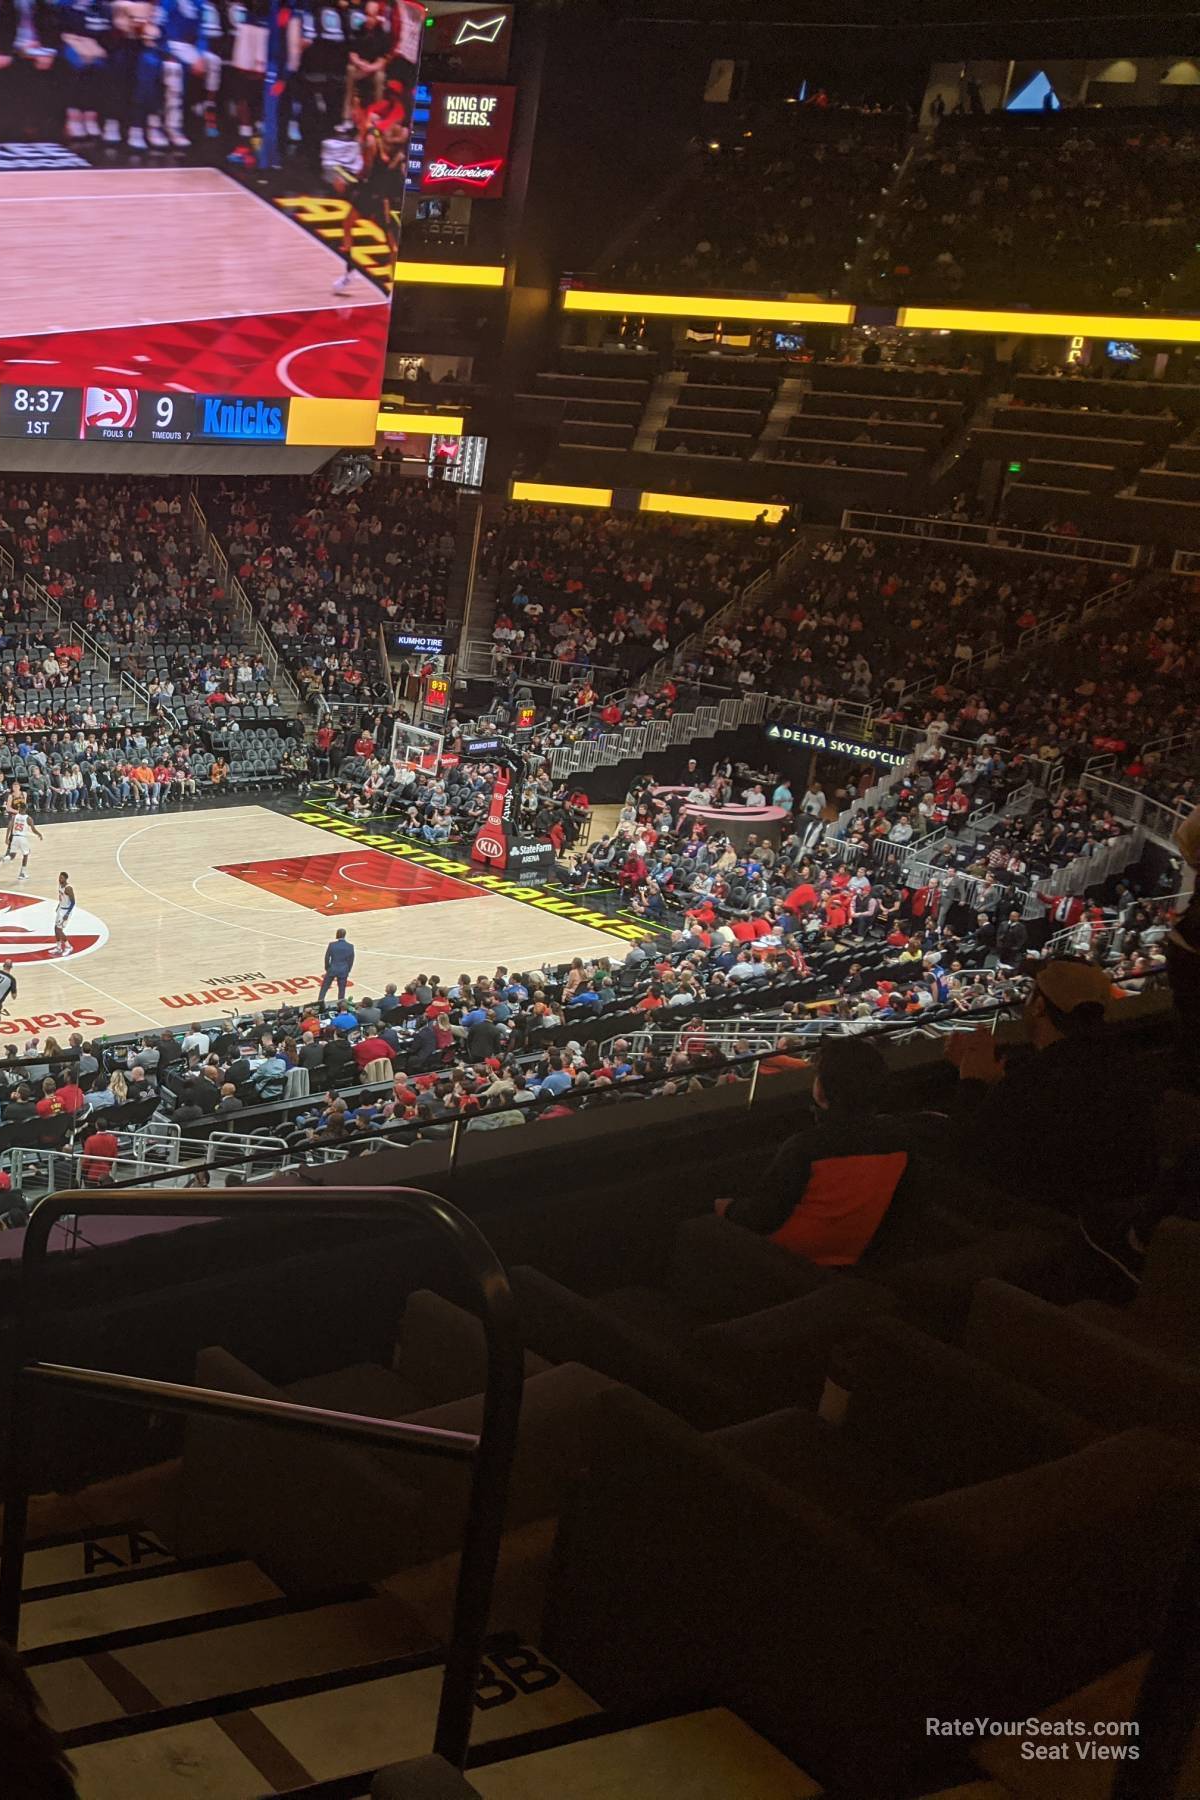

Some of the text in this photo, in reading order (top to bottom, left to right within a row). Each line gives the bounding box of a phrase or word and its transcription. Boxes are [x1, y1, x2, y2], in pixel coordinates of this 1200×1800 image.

[446, 96, 497, 111] KING OF
[448, 111, 491, 126] BEERS.
[429, 163, 495, 178] Budweiser
[14, 389, 63, 412] 8:37
[155, 397, 173, 427] 9
[203, 399, 281, 435] Knicks
[27, 421, 49, 434] 1ST
[103, 430, 123, 438] FOULS
[152, 431, 181, 440] TIMEOUTS
[398, 636, 425, 645] KUMHO
[783, 728, 826, 747] DELTA
[502, 788, 514, 822] xfinity
[292, 811, 472, 875] ATLANTA
[480, 840, 498, 855] KIA
[521, 854, 540, 864] ARENA
[468, 874, 659, 939] HAWKS
[200, 971, 266, 986] ARENA
[83, 1530, 176, 1575] AA
